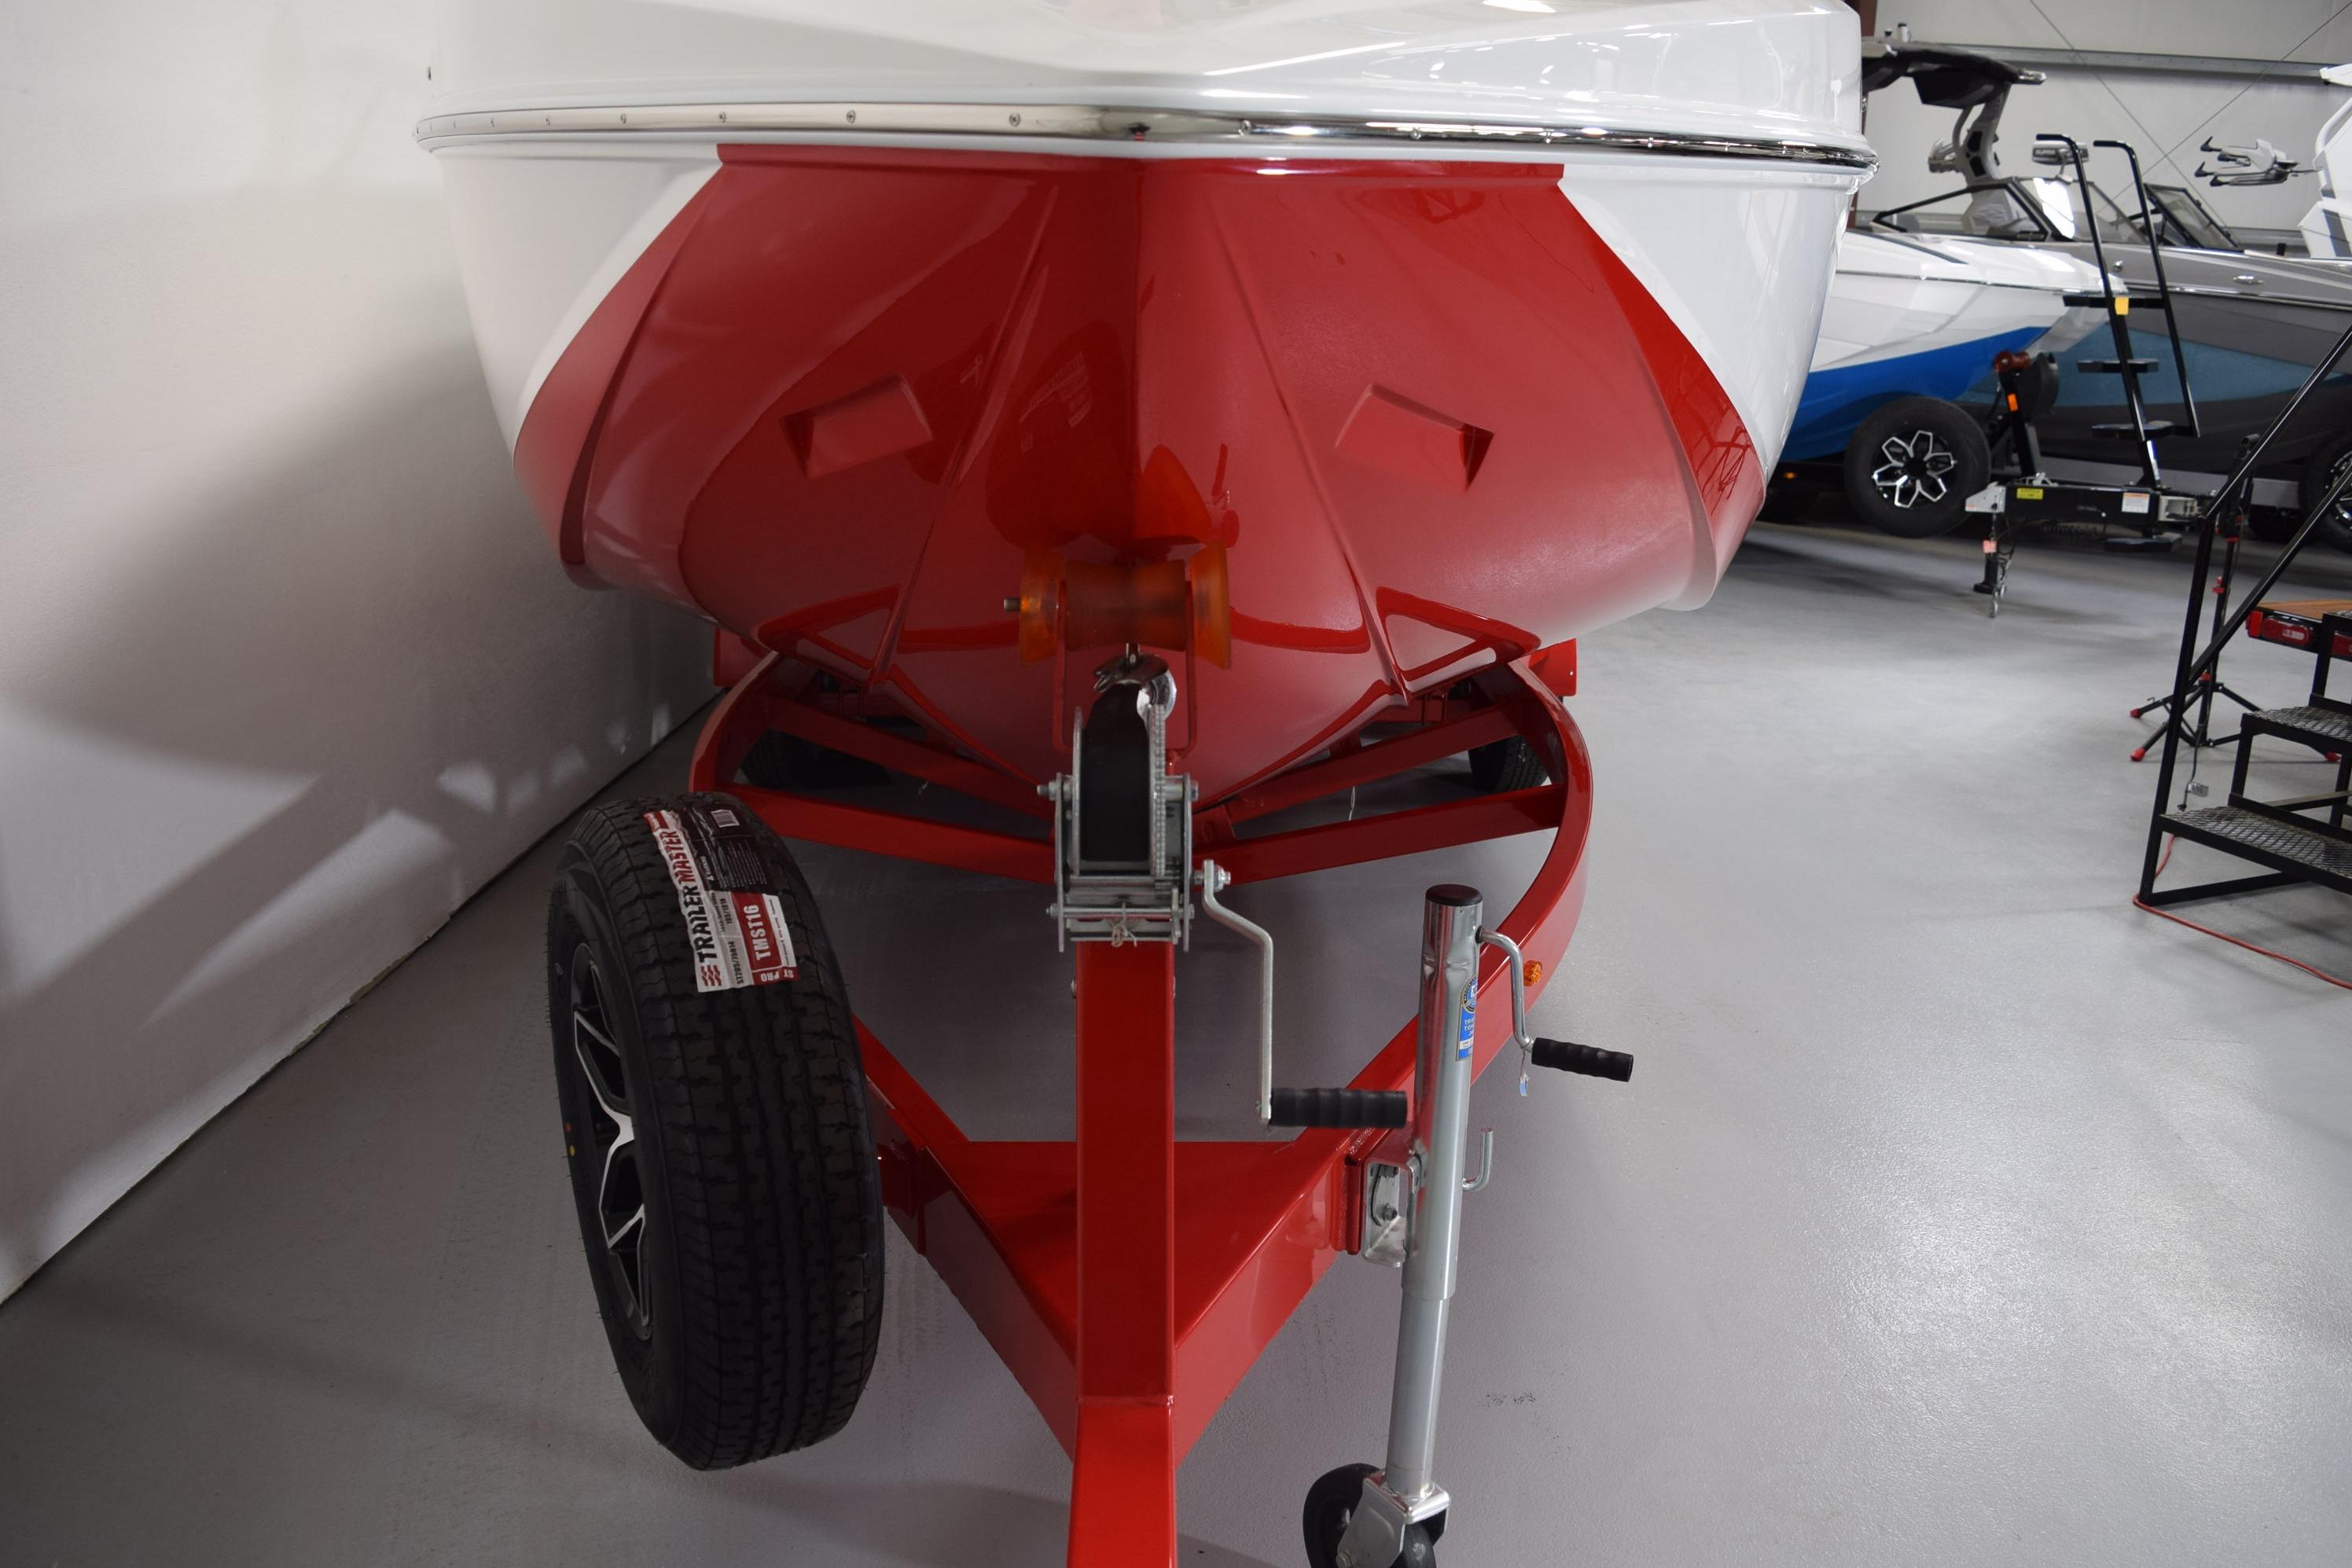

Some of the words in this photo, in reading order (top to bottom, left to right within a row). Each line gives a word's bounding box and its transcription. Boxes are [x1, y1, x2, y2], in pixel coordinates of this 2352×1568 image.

[660, 831, 696, 884] MASTER
[682, 885, 717, 964] TRAILER
[743, 904, 772, 961] TMST16
[760, 971, 780, 982] PRO
[783, 969, 794, 979] ST
